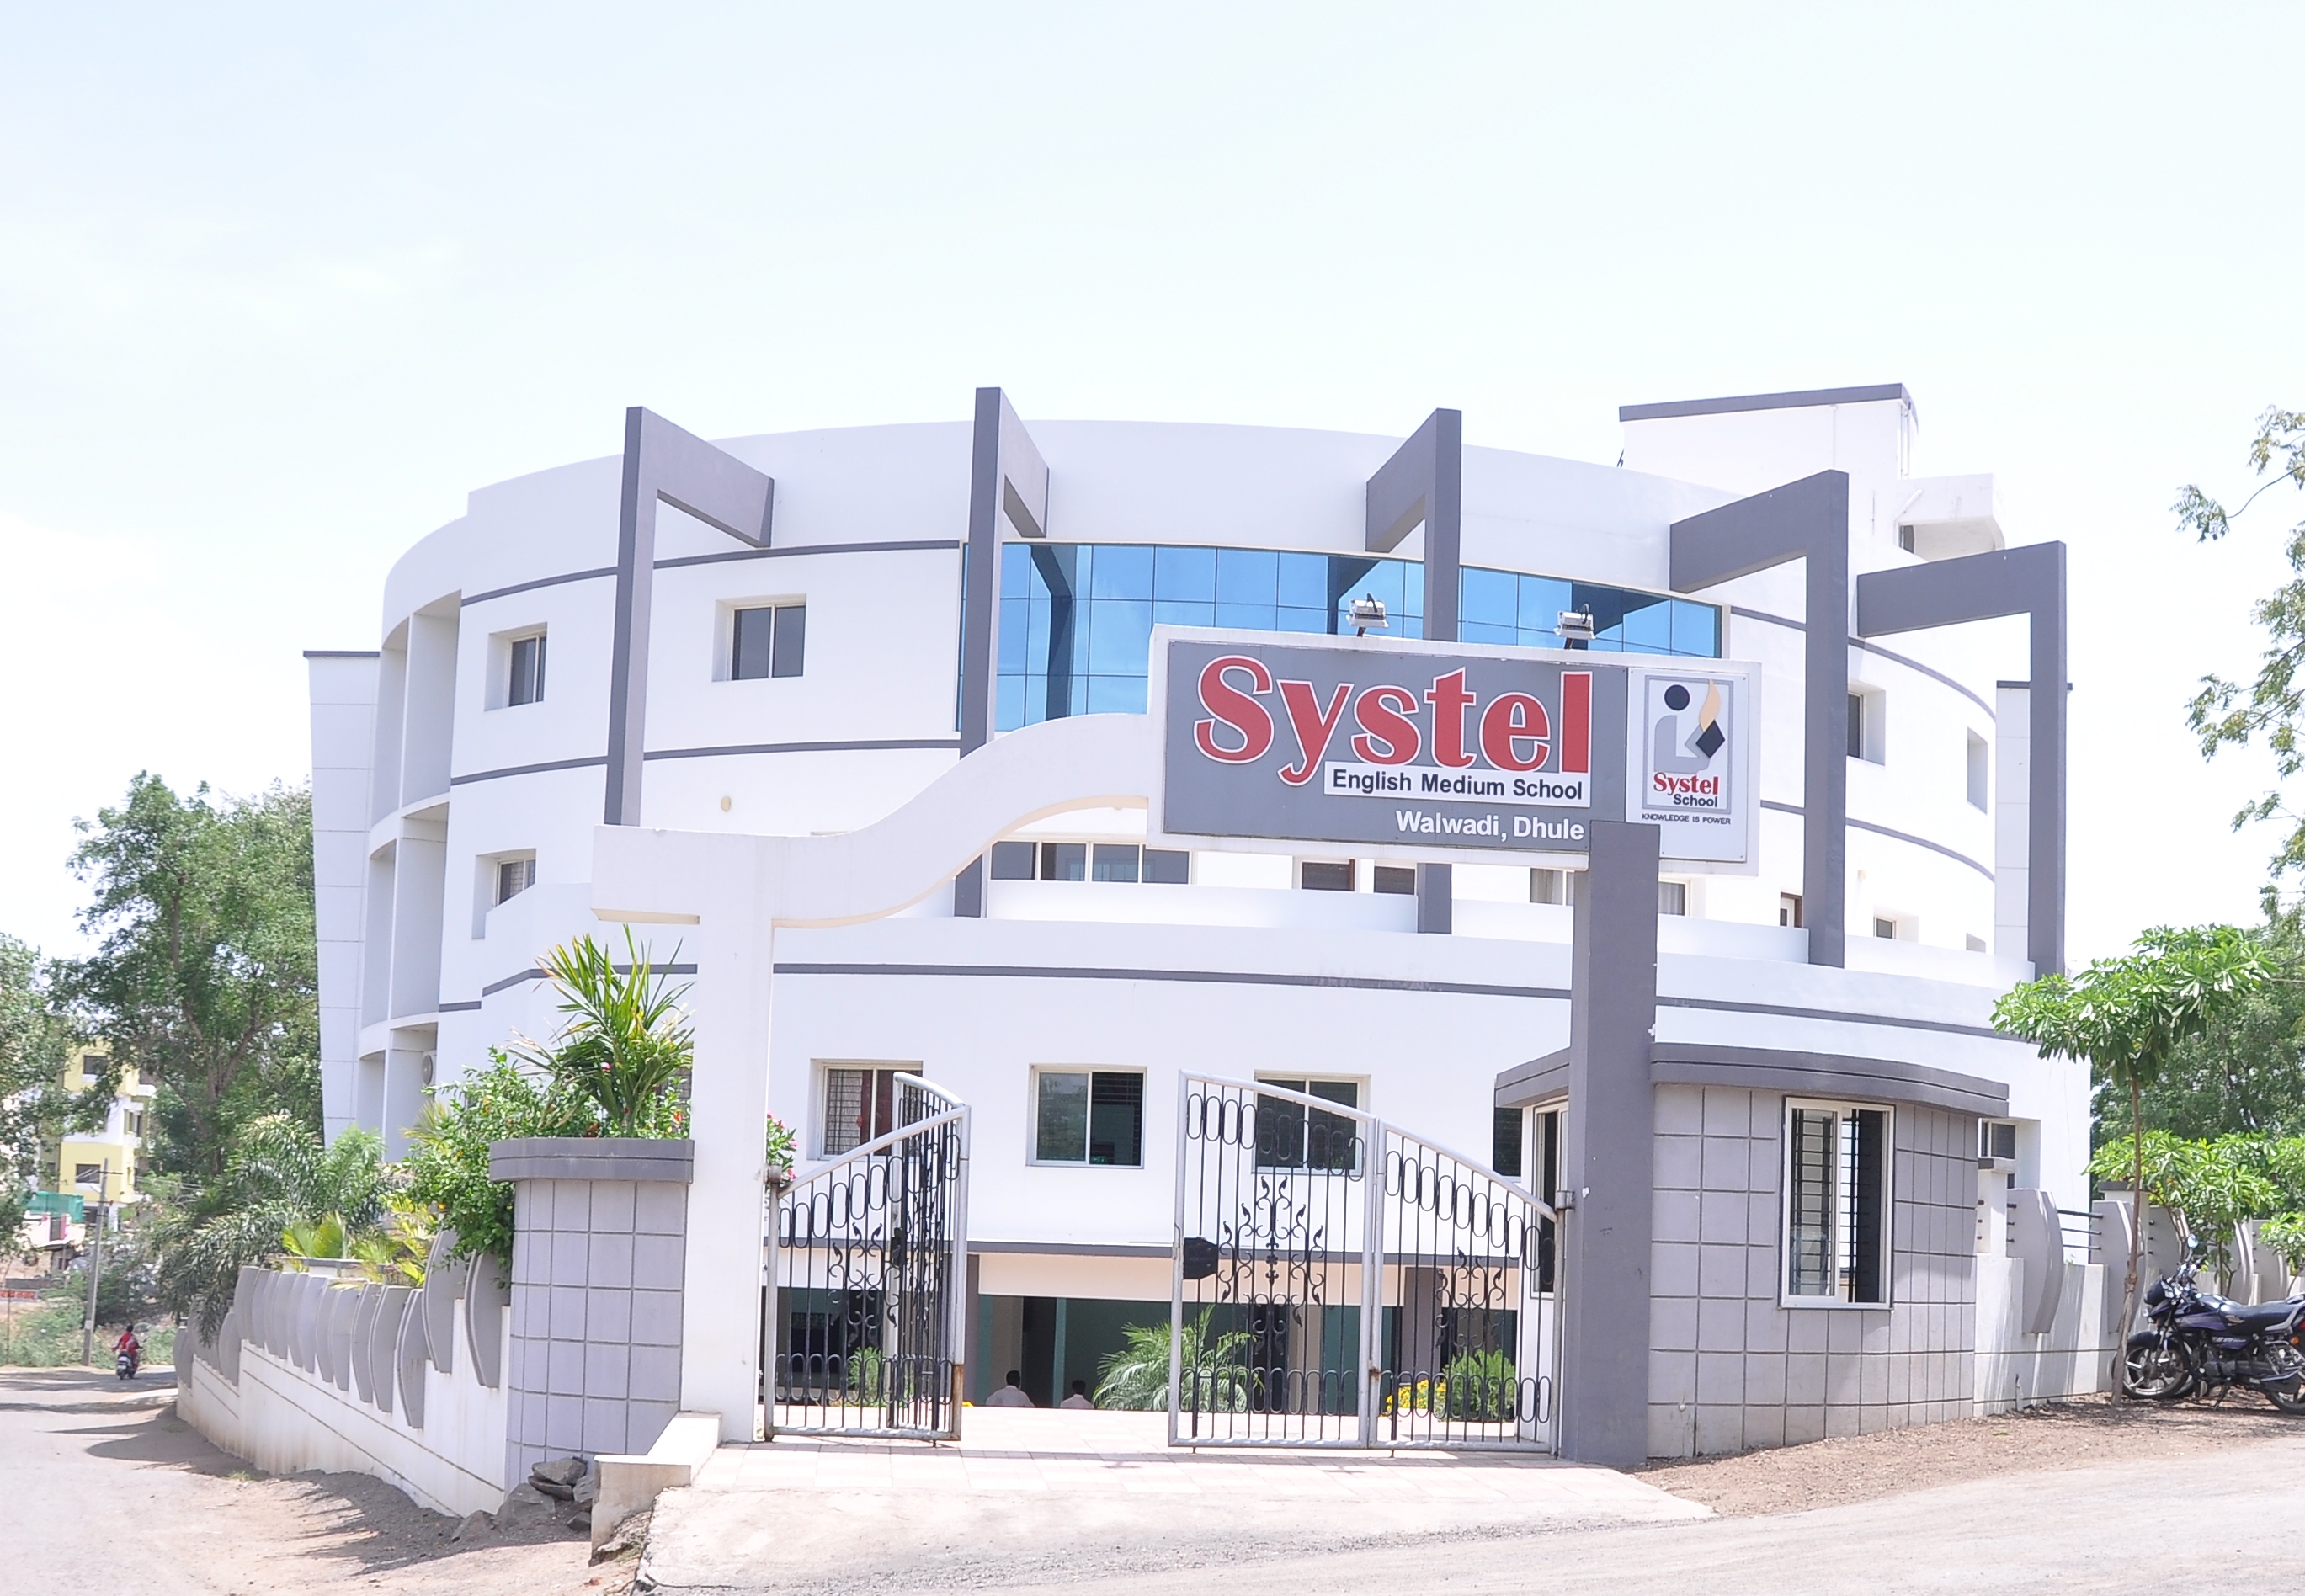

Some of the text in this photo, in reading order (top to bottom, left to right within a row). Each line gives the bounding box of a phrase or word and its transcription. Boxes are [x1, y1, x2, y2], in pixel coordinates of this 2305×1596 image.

[1194, 655, 1593, 785] Systel
[1333, 769, 1583, 800] English Medium School
[1653, 772, 1719, 795] Systel
[1673, 794, 1718, 807] School
[1396, 810, 1585, 842] Walwadi, Dhule
[1642, 813, 1690, 822] KNOWLEDGE
[1702, 817, 1731, 825] POWER
